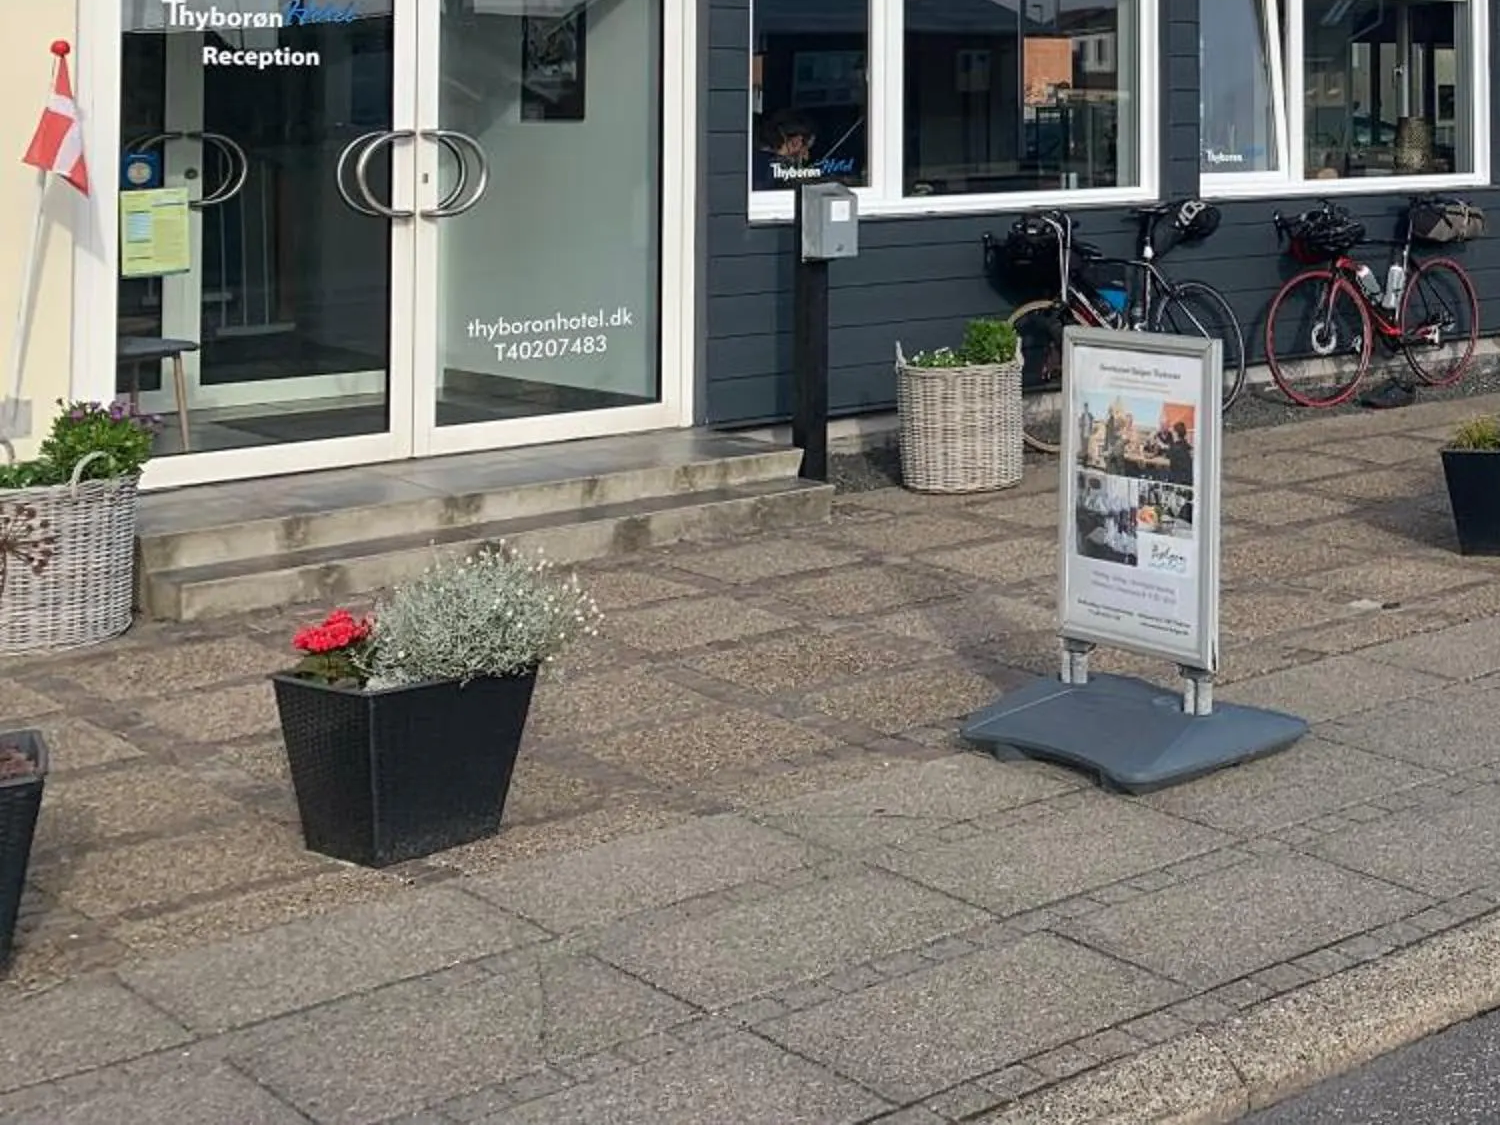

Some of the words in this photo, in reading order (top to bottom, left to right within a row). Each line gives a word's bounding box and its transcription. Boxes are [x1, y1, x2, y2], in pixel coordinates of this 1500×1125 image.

[202, 46, 321, 70] Reception
[467, 306, 633, 342] thyboronhotel.dk
[494, 334, 608, 362] T40207483
